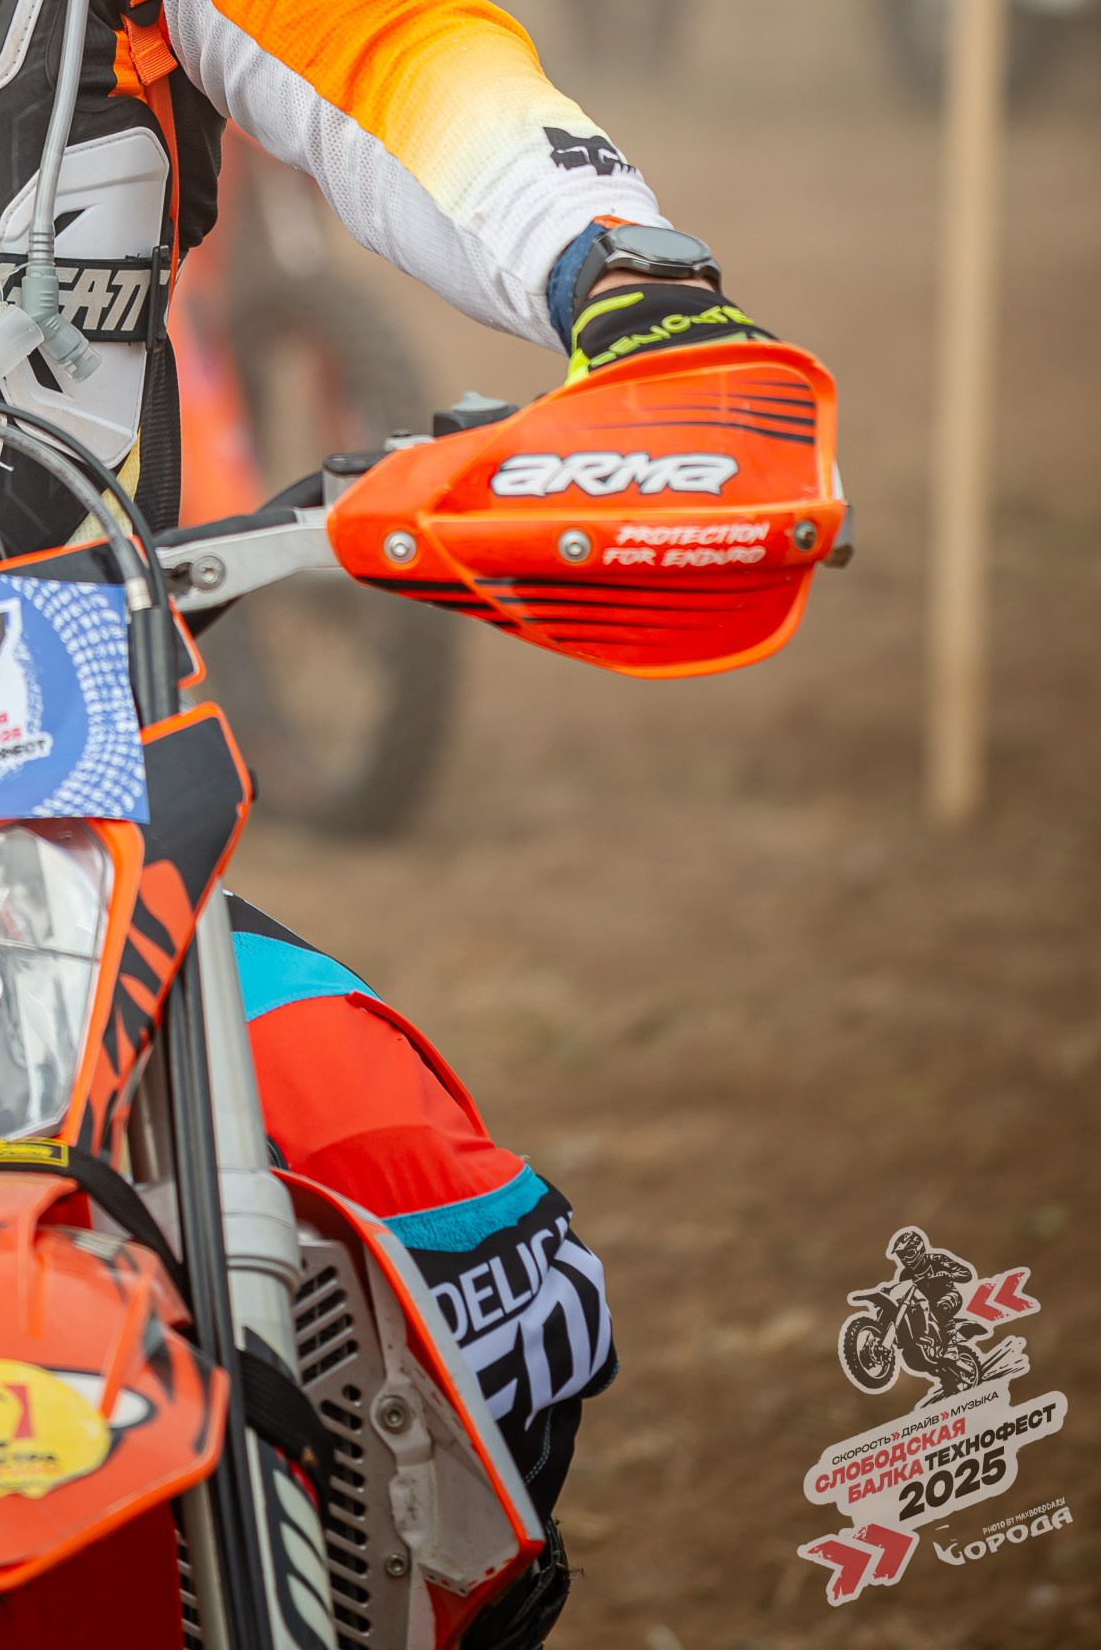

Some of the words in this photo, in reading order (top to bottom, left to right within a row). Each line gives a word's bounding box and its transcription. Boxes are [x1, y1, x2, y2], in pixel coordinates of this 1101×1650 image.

[615, 521, 770, 546] PROTECTION
[602, 546, 656, 566] FOR
[660, 545, 766, 568] ENDURO
